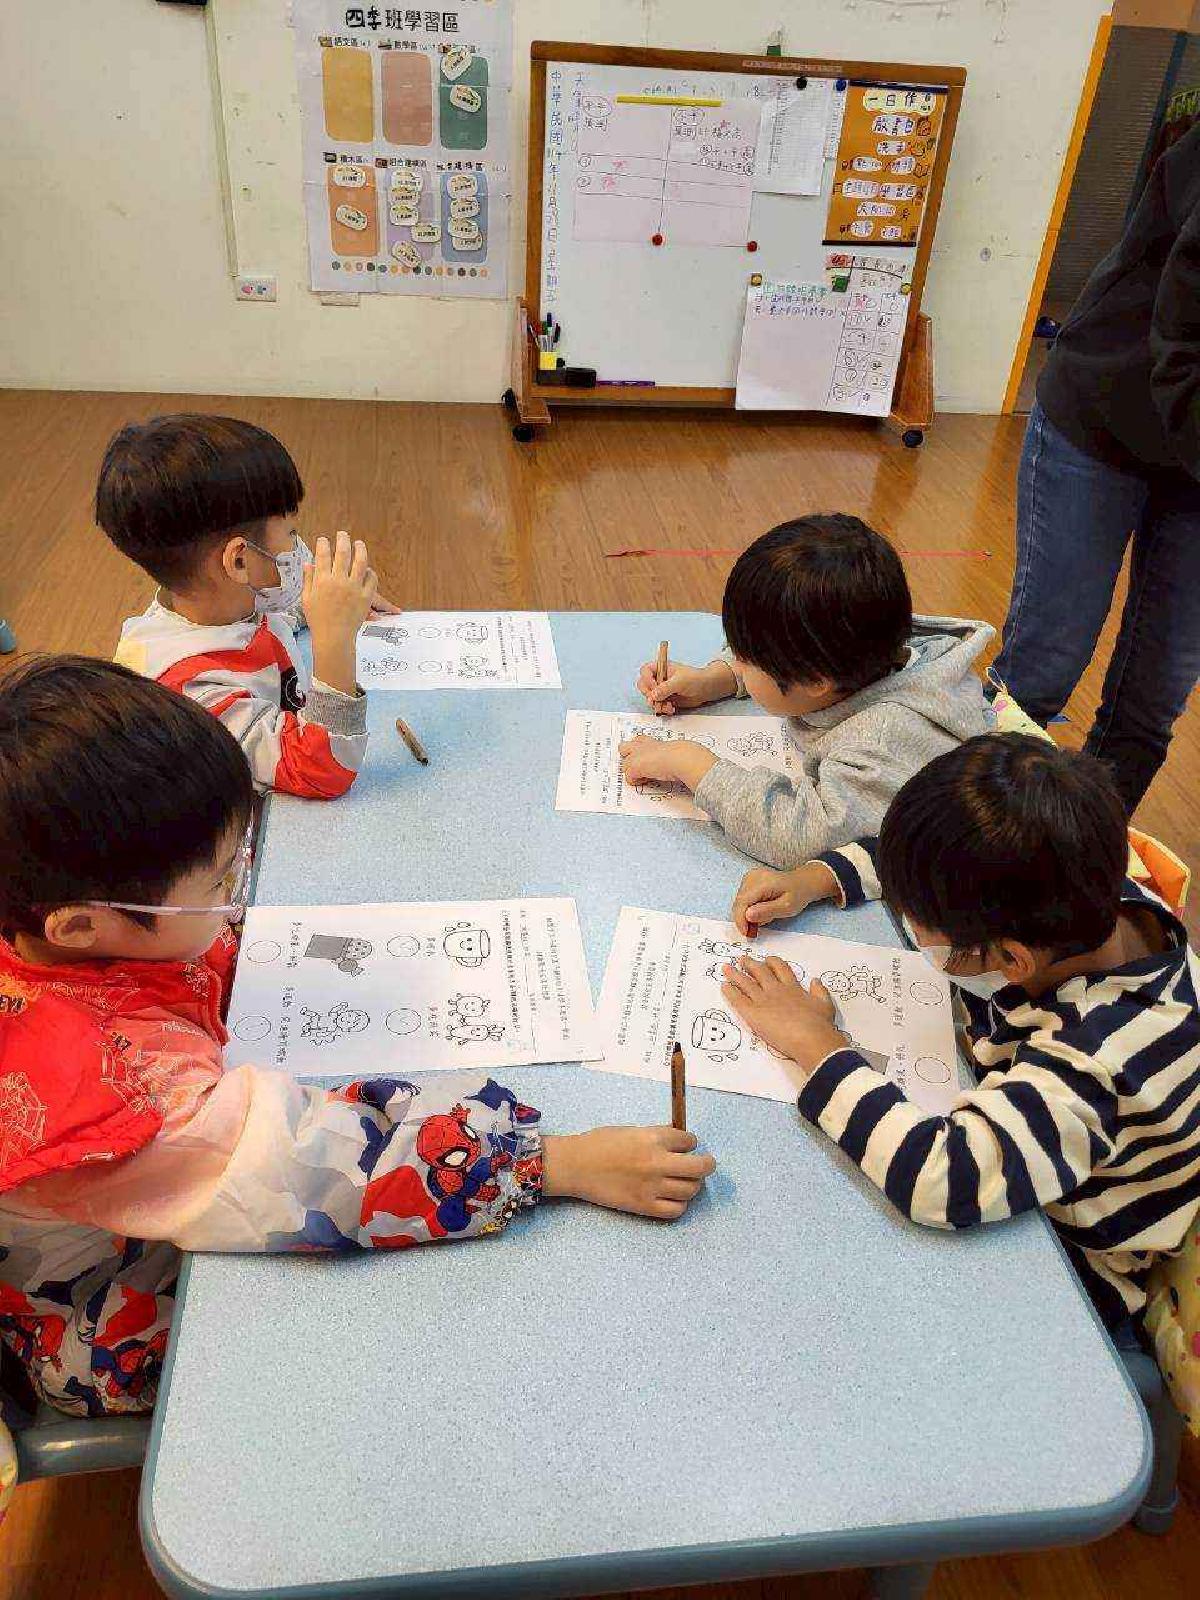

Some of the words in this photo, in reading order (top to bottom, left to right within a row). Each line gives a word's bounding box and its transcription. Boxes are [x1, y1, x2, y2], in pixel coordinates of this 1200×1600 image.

[345, 5, 461, 33] 四季班學習區
